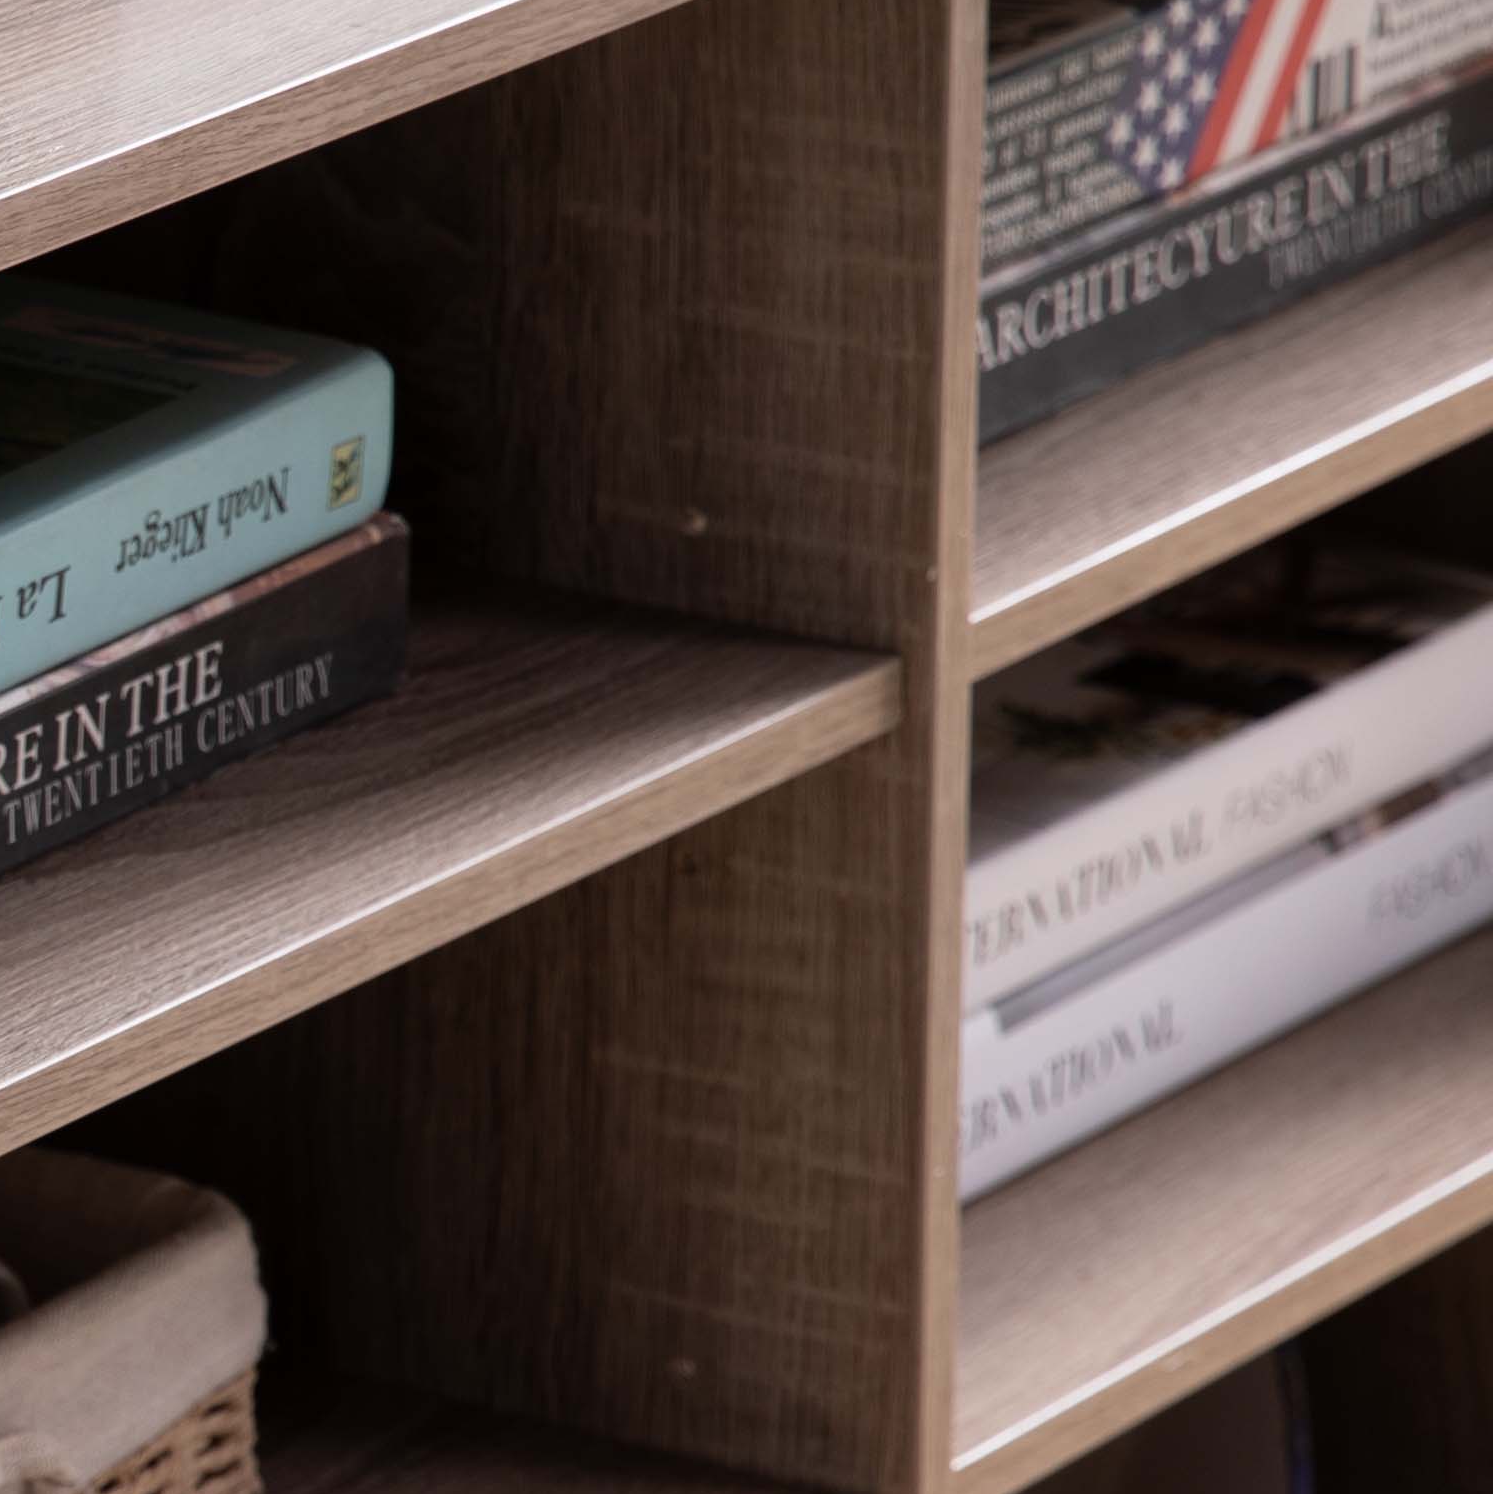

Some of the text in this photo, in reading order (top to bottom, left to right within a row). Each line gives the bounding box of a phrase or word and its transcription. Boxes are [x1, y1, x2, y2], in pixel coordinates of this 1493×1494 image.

[1306, 152, 1356, 227] IN
[116, 467, 289, 572] Noah Klieger
[17, 565, 71, 623] La
[3, 653, 333, 844] TWENTIETH CENTURY
[54, 692, 111, 771] IN
[121, 641, 224, 738] THE
